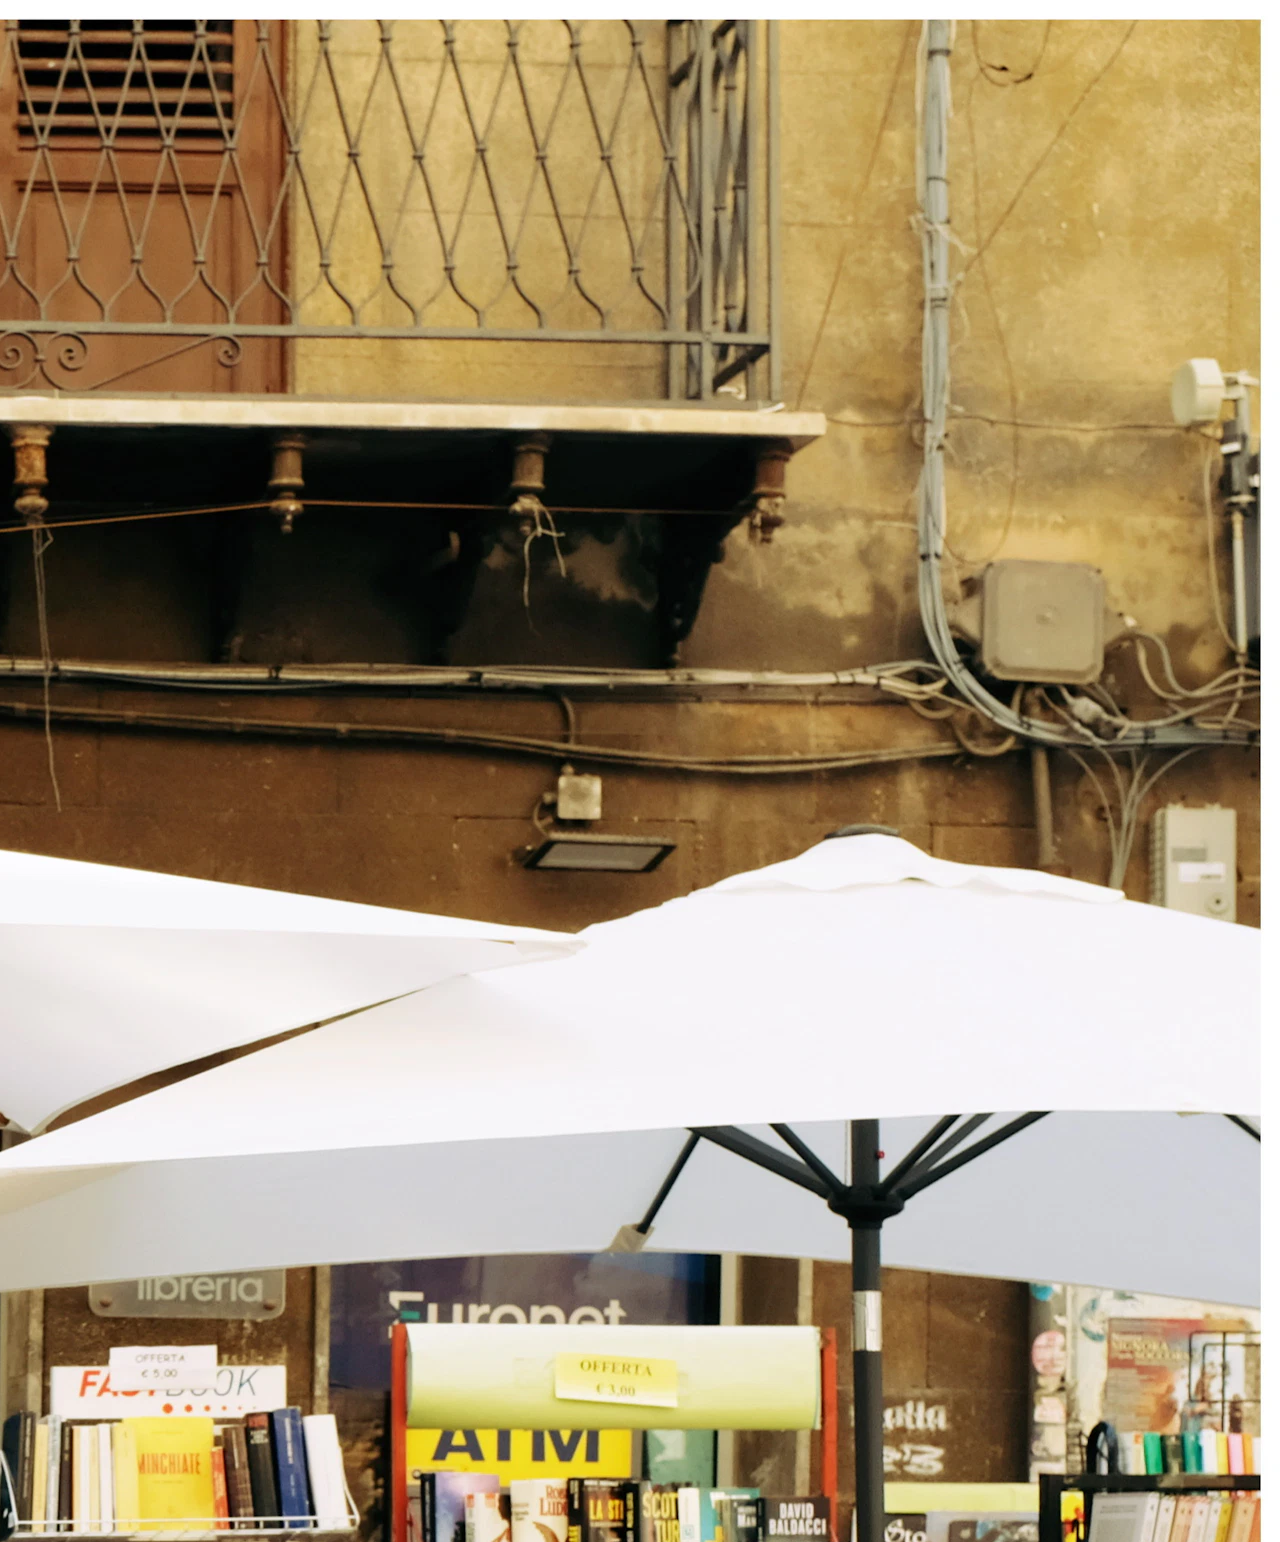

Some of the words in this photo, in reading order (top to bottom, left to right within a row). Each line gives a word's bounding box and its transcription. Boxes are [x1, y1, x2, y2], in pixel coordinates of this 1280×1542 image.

[137, 1276, 264, 1302] libreria
[135, 1354, 185, 1364] OFFERTA
[579, 1359, 653, 1377] OFFERTA
[137, 1452, 202, 1476] MINCHIATE
[779, 1502, 815, 1519] DAVID
[768, 1519, 827, 1536] BALDACCI
